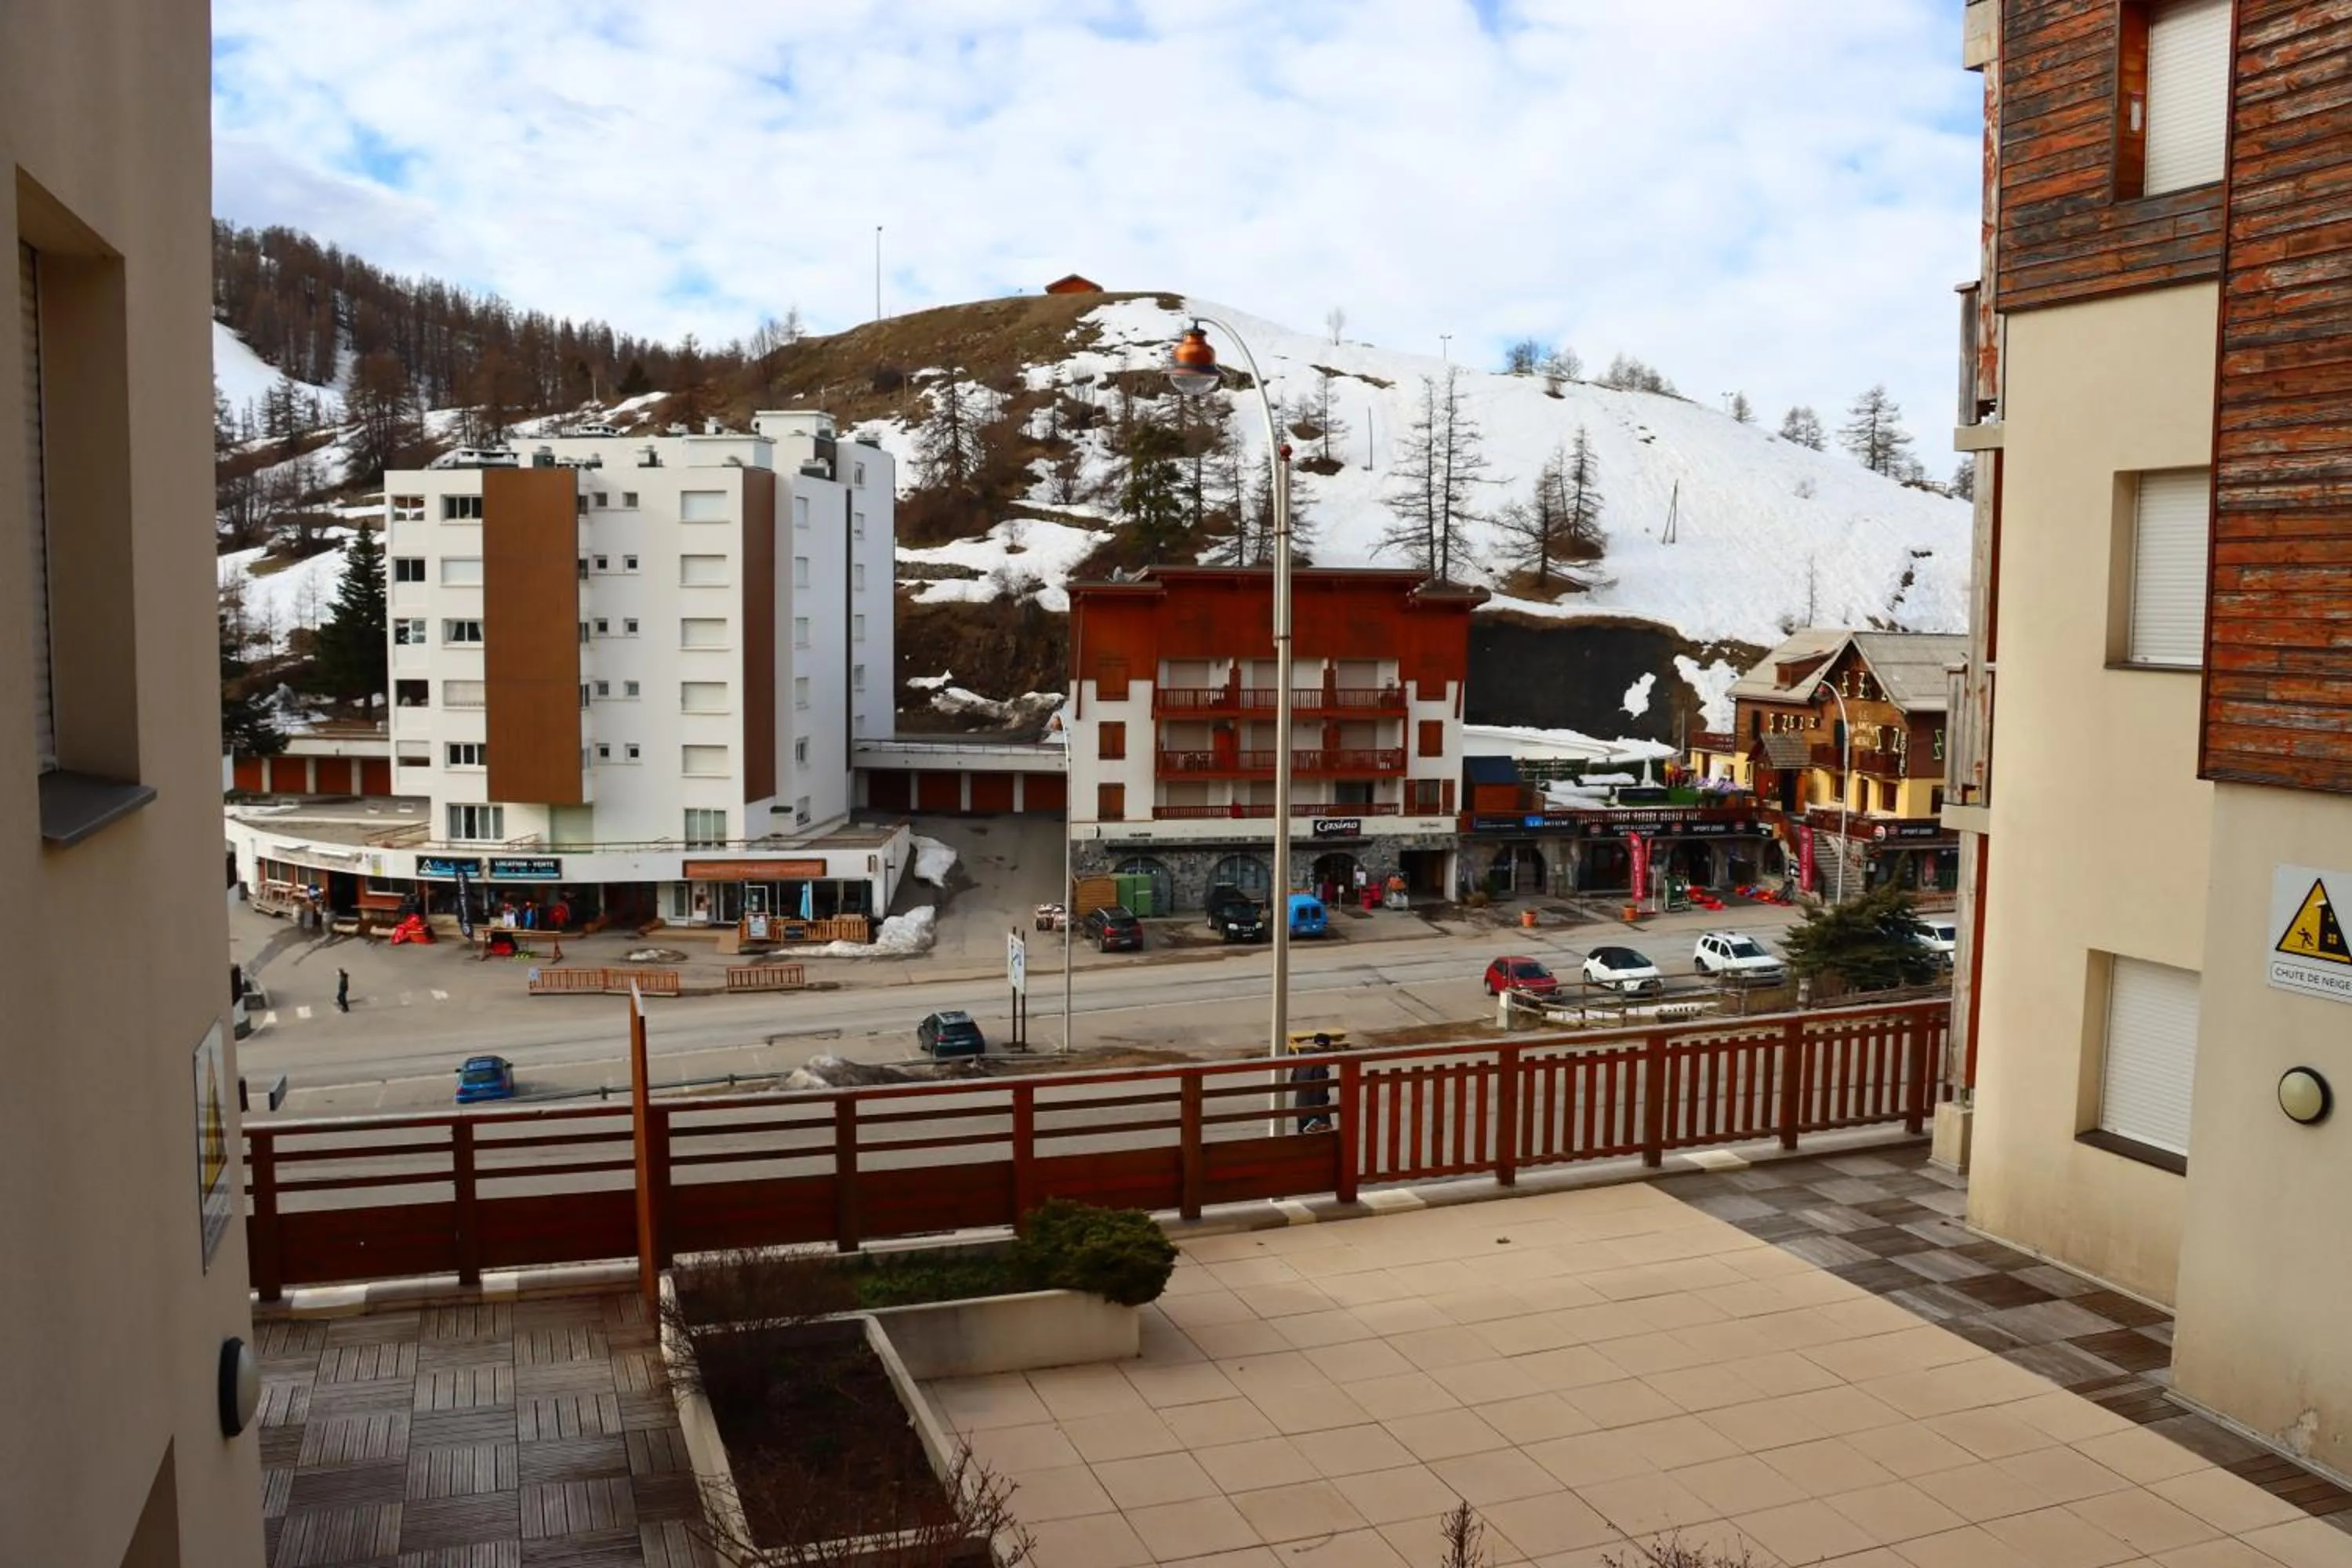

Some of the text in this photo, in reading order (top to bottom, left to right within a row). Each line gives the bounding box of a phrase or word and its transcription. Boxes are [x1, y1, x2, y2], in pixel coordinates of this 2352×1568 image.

[1316, 820, 1358, 832] Casino
[2275, 967, 2351, 990] CHUTE DE NEIGE
